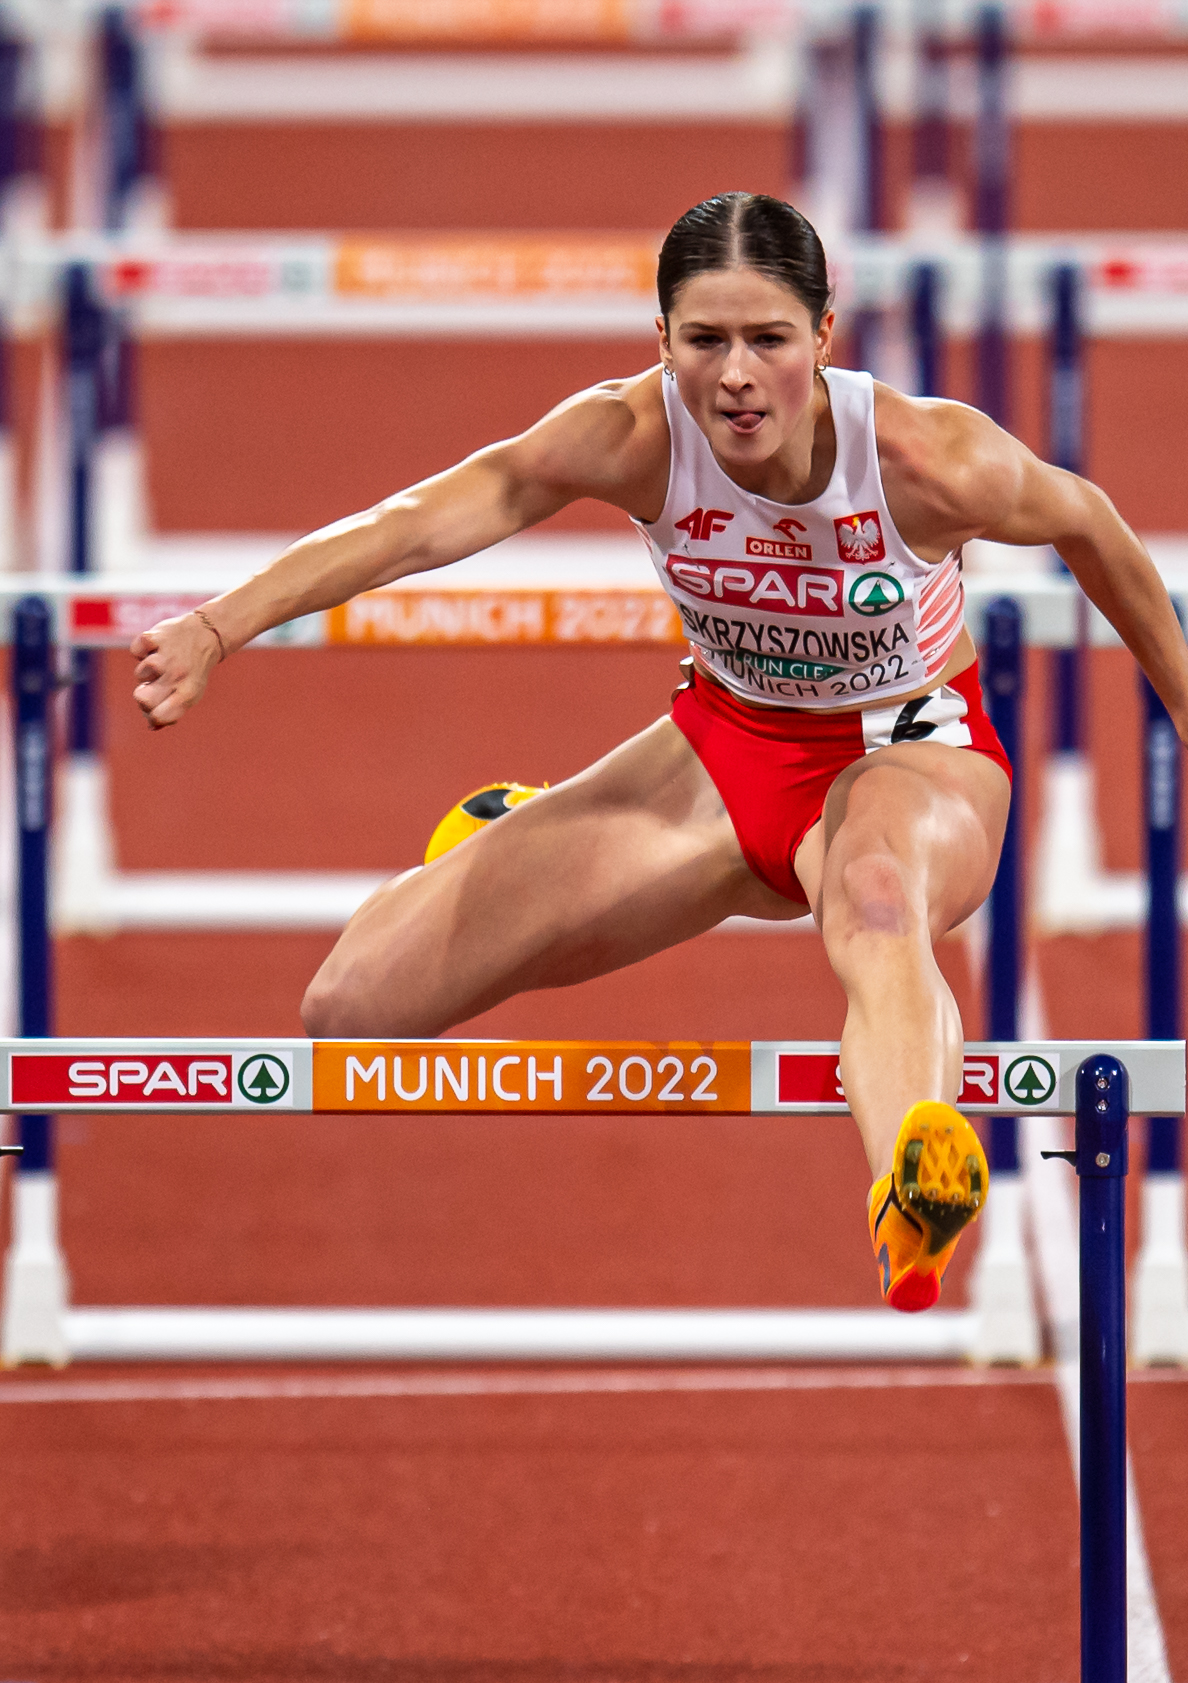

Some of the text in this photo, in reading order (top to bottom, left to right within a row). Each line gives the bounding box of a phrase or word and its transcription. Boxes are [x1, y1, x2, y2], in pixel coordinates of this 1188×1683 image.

[749, 541, 808, 559] ORLEN
[670, 562, 838, 612] SPAR
[679, 602, 910, 663] SKRZYSZOWSKA
[830, 654, 910, 697] 2022
[68, 1055, 718, 1102] SPAR MUNICH 2022
